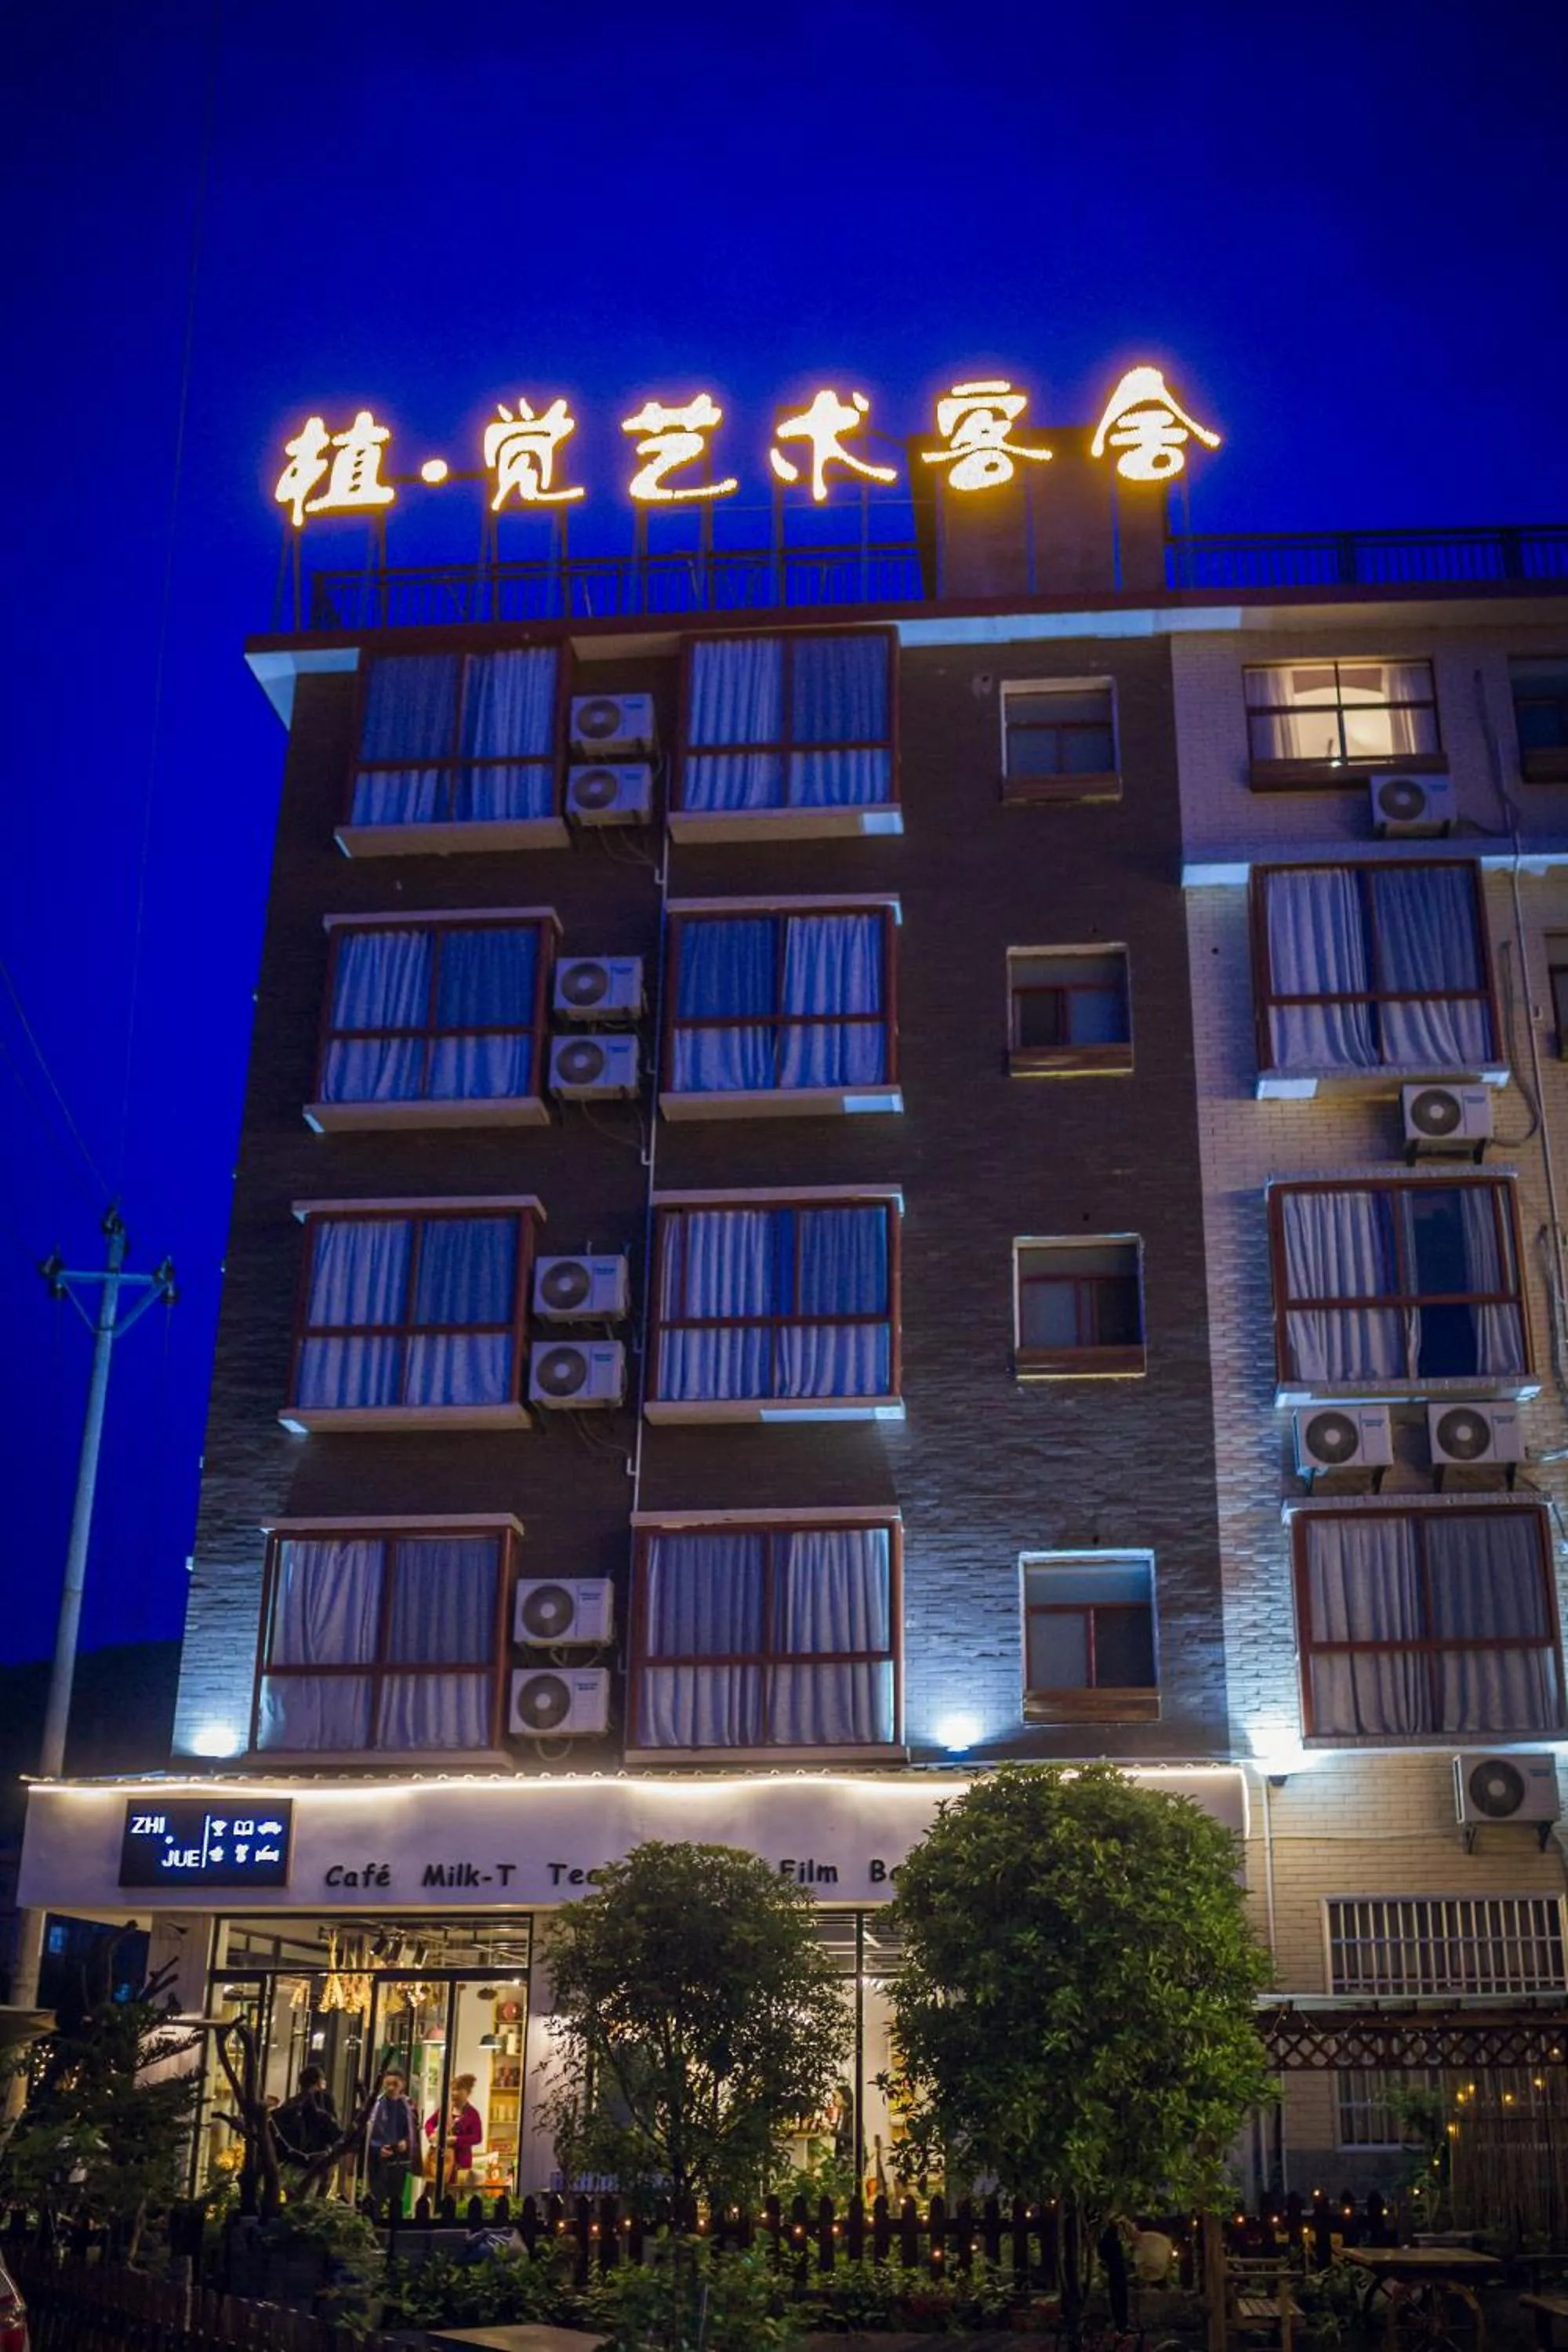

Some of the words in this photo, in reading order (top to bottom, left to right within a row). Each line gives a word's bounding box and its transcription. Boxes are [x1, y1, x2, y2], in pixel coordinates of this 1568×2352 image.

[162, 1849, 201, 1867] JUE
[325, 1863, 390, 1888] Café
[421, 1863, 517, 1887] Milk-T
[779, 1859, 838, 1883] Film
